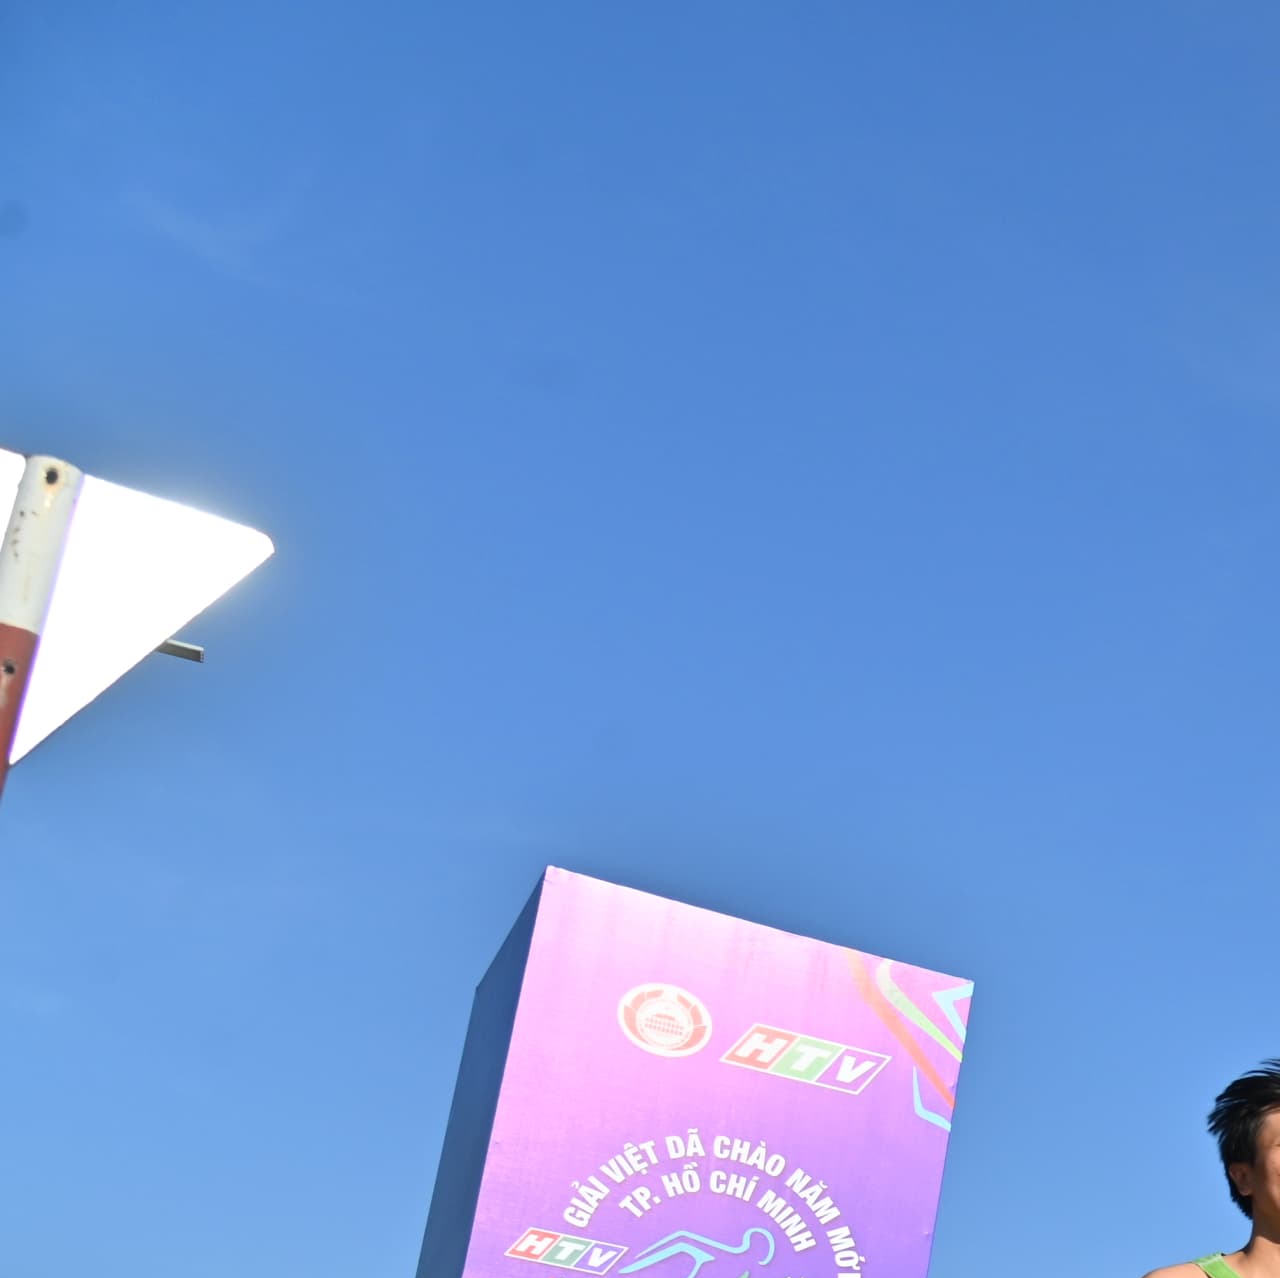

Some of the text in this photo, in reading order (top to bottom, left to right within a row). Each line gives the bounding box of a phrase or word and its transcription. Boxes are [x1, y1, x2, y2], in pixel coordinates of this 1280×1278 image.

[730, 1027, 884, 1089] HTV
[562, 1178, 611, 1229] GIẢI
[600, 1141, 661, 1185] VIỆT
[664, 1127, 707, 1160] DÃ
[712, 1134, 787, 1178] CHÀO
[784, 1167, 842, 1225] NĂM
[618, 1161, 817, 1253] TP. HỒ CHÍ MINH
[510, 1230, 622, 1271] HTV
